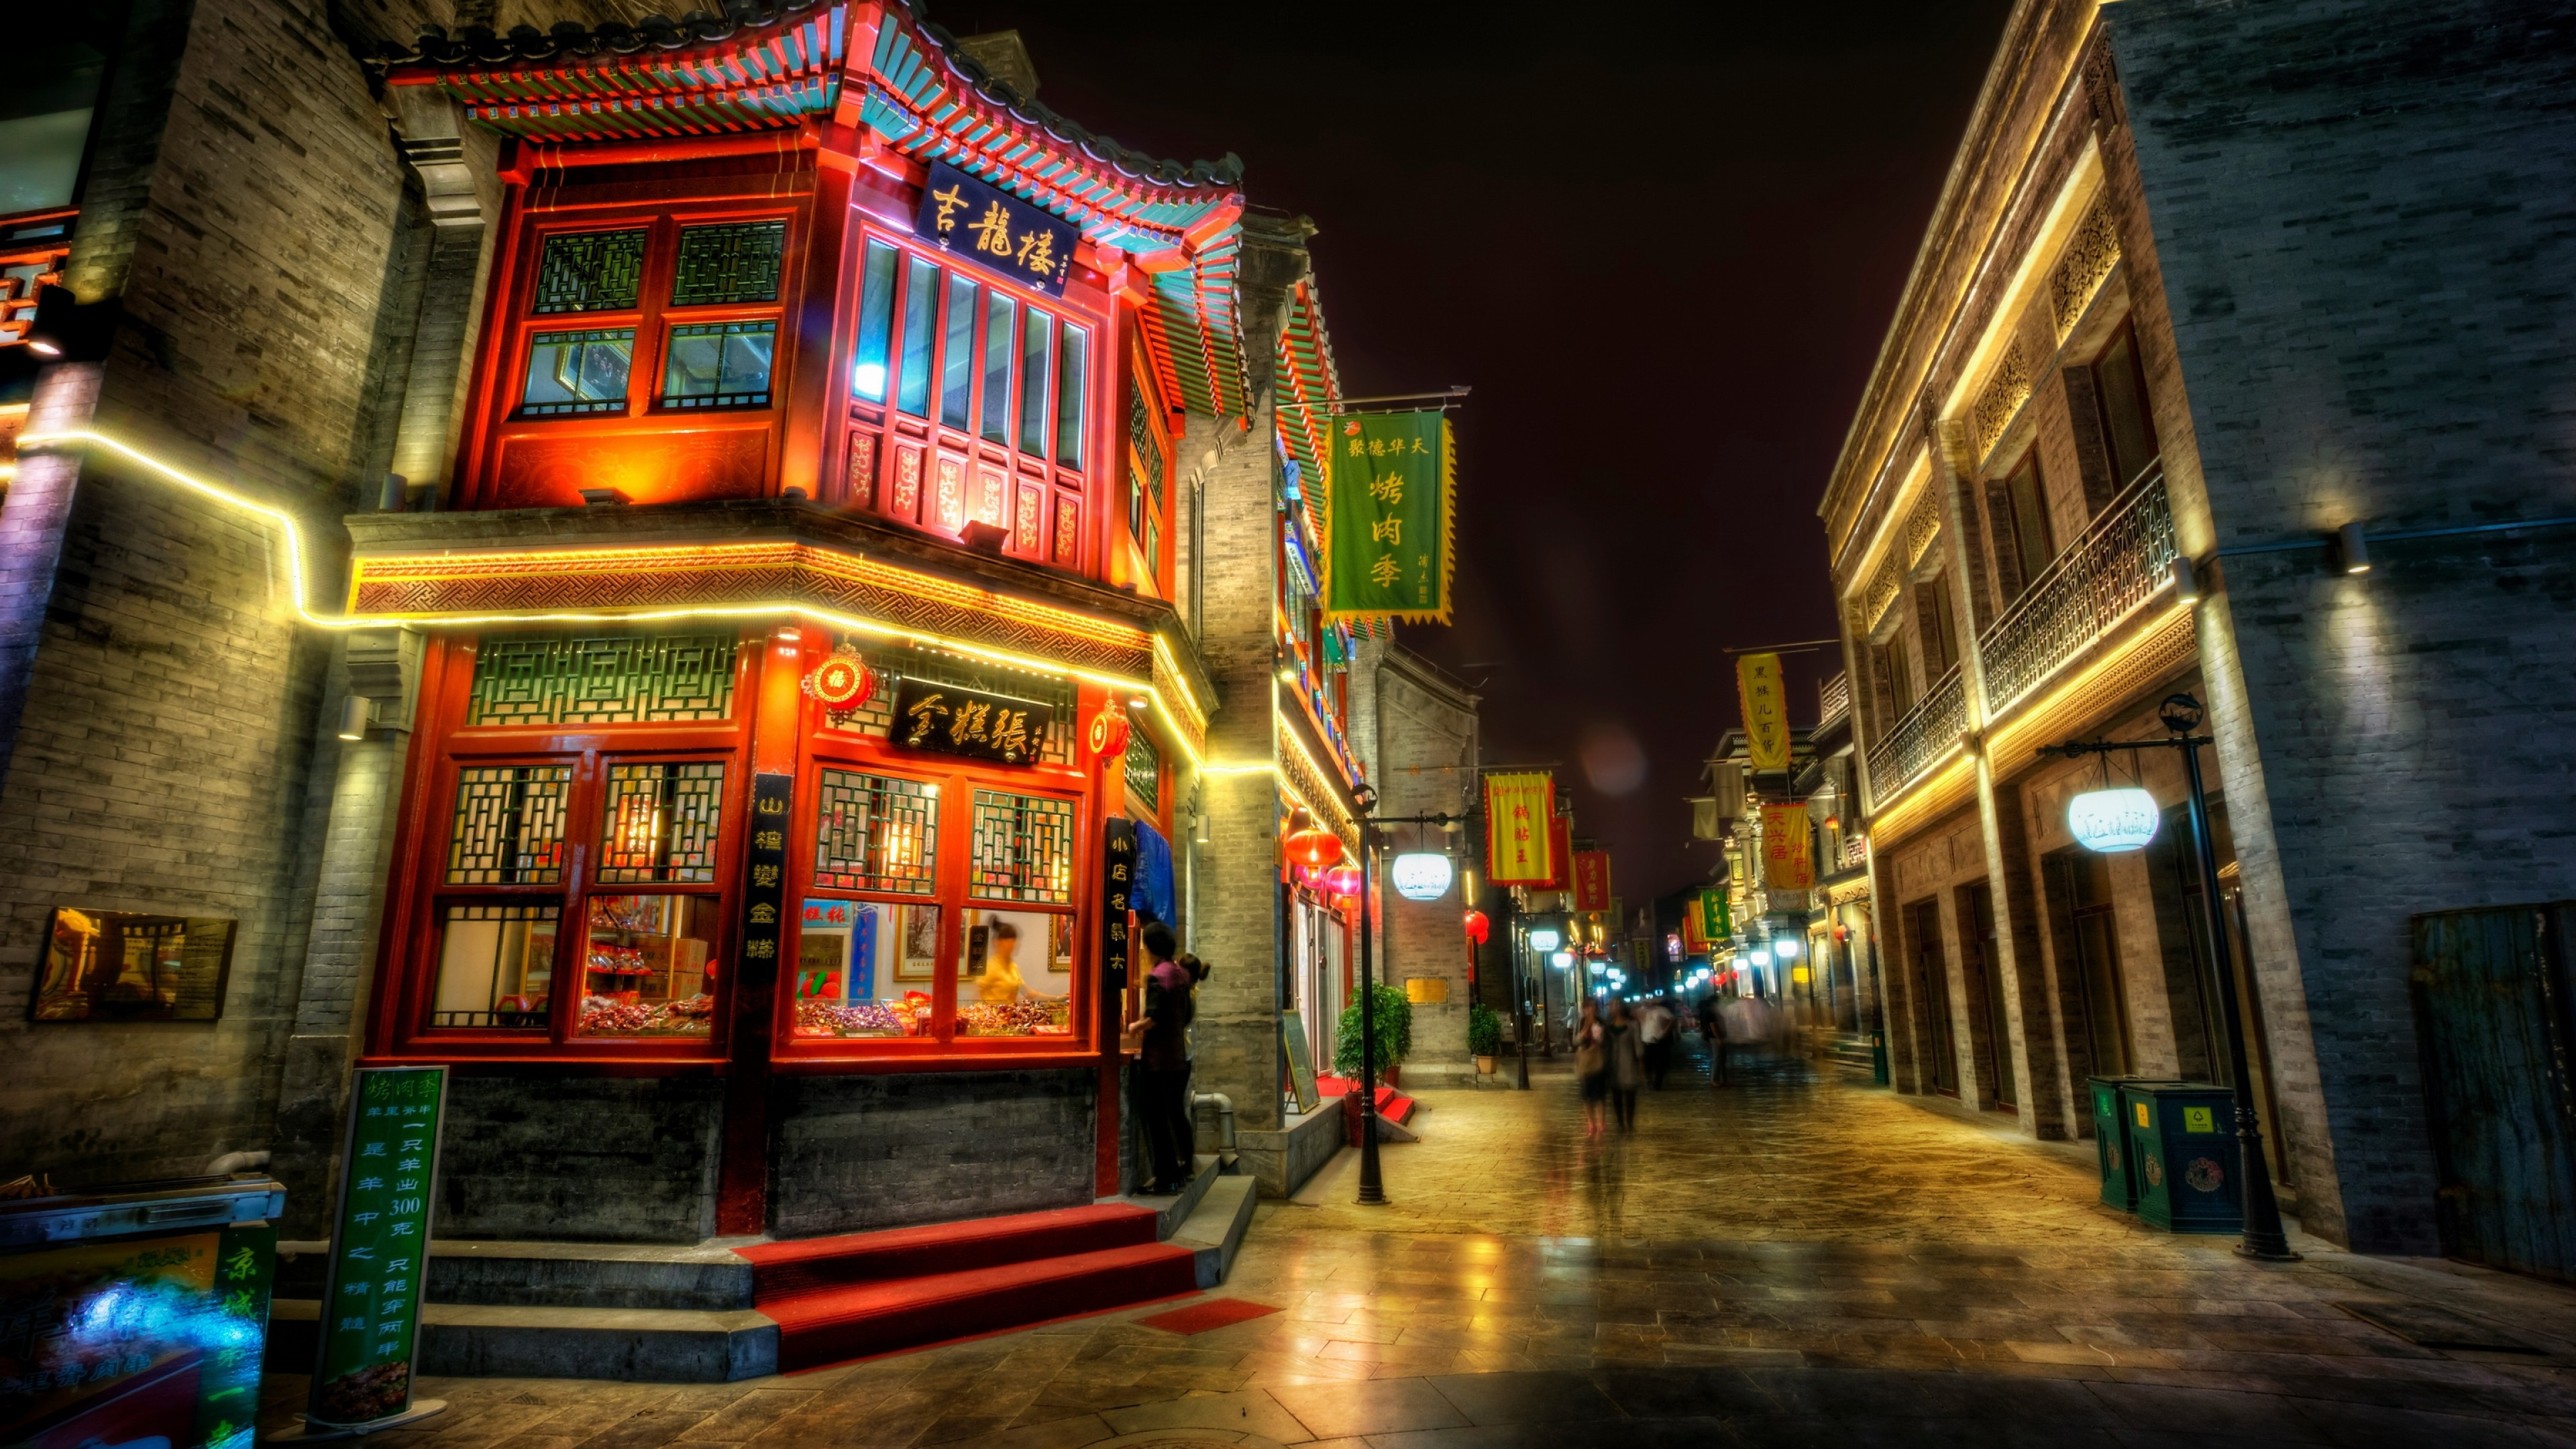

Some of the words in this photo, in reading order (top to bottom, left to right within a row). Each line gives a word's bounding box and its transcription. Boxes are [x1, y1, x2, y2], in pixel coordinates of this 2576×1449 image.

[1348, 437, 1429, 457] 聚德华天
[1369, 470, 1404, 588] 烤肉季
[1754, 666, 1775, 754] 黑猴儿百货
[1766, 812, 1788, 860] 天兴居
[1792, 843, 1809, 884] 炒肝店
[365, 1073, 436, 1101] 烤肉季
